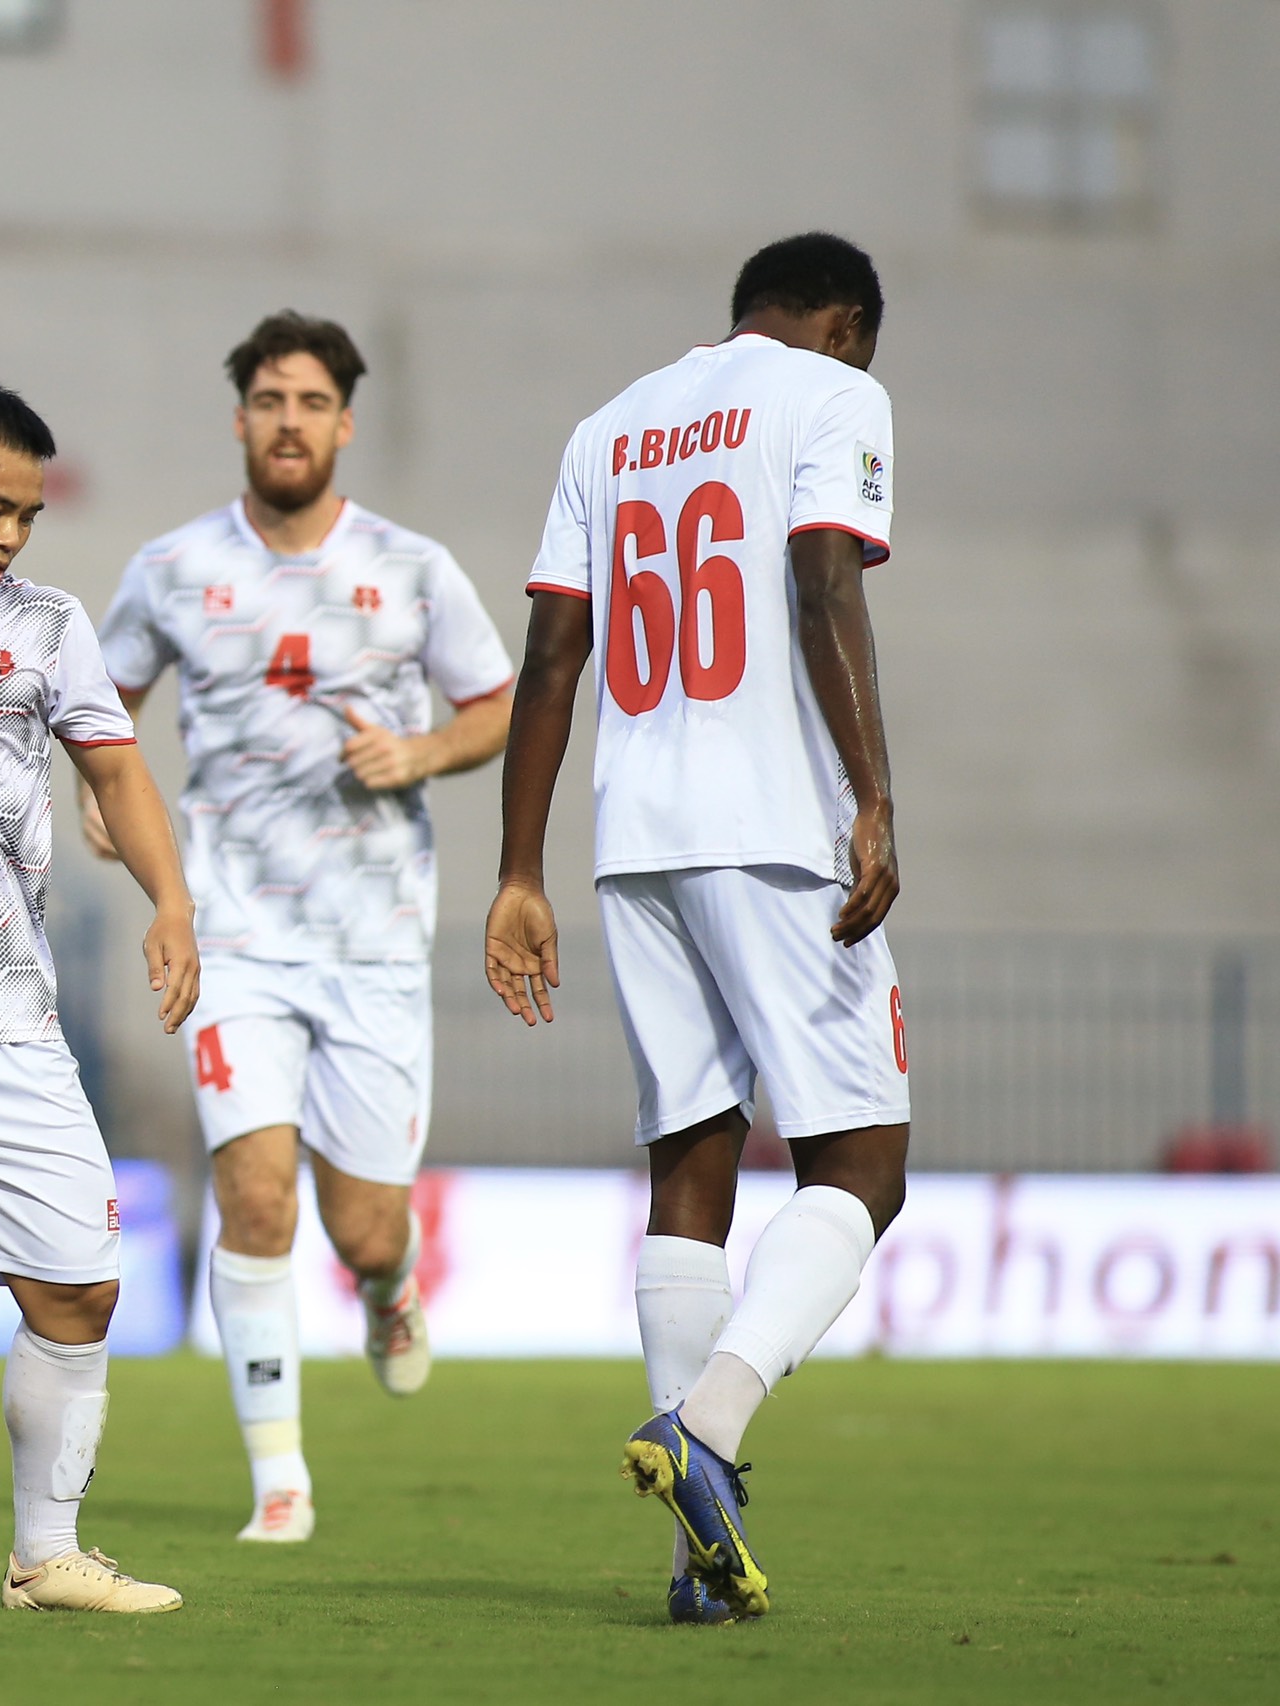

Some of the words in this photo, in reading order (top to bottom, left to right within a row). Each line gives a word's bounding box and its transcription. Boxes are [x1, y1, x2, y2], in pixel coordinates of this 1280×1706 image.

[612, 408, 753, 477] B.BICOU
[861, 488, 884, 503] CUP
[862, 478, 883, 495] AFC
[605, 480, 747, 718] 66
[265, 633, 317, 703] 4
[195, 1024, 234, 1093] 4
